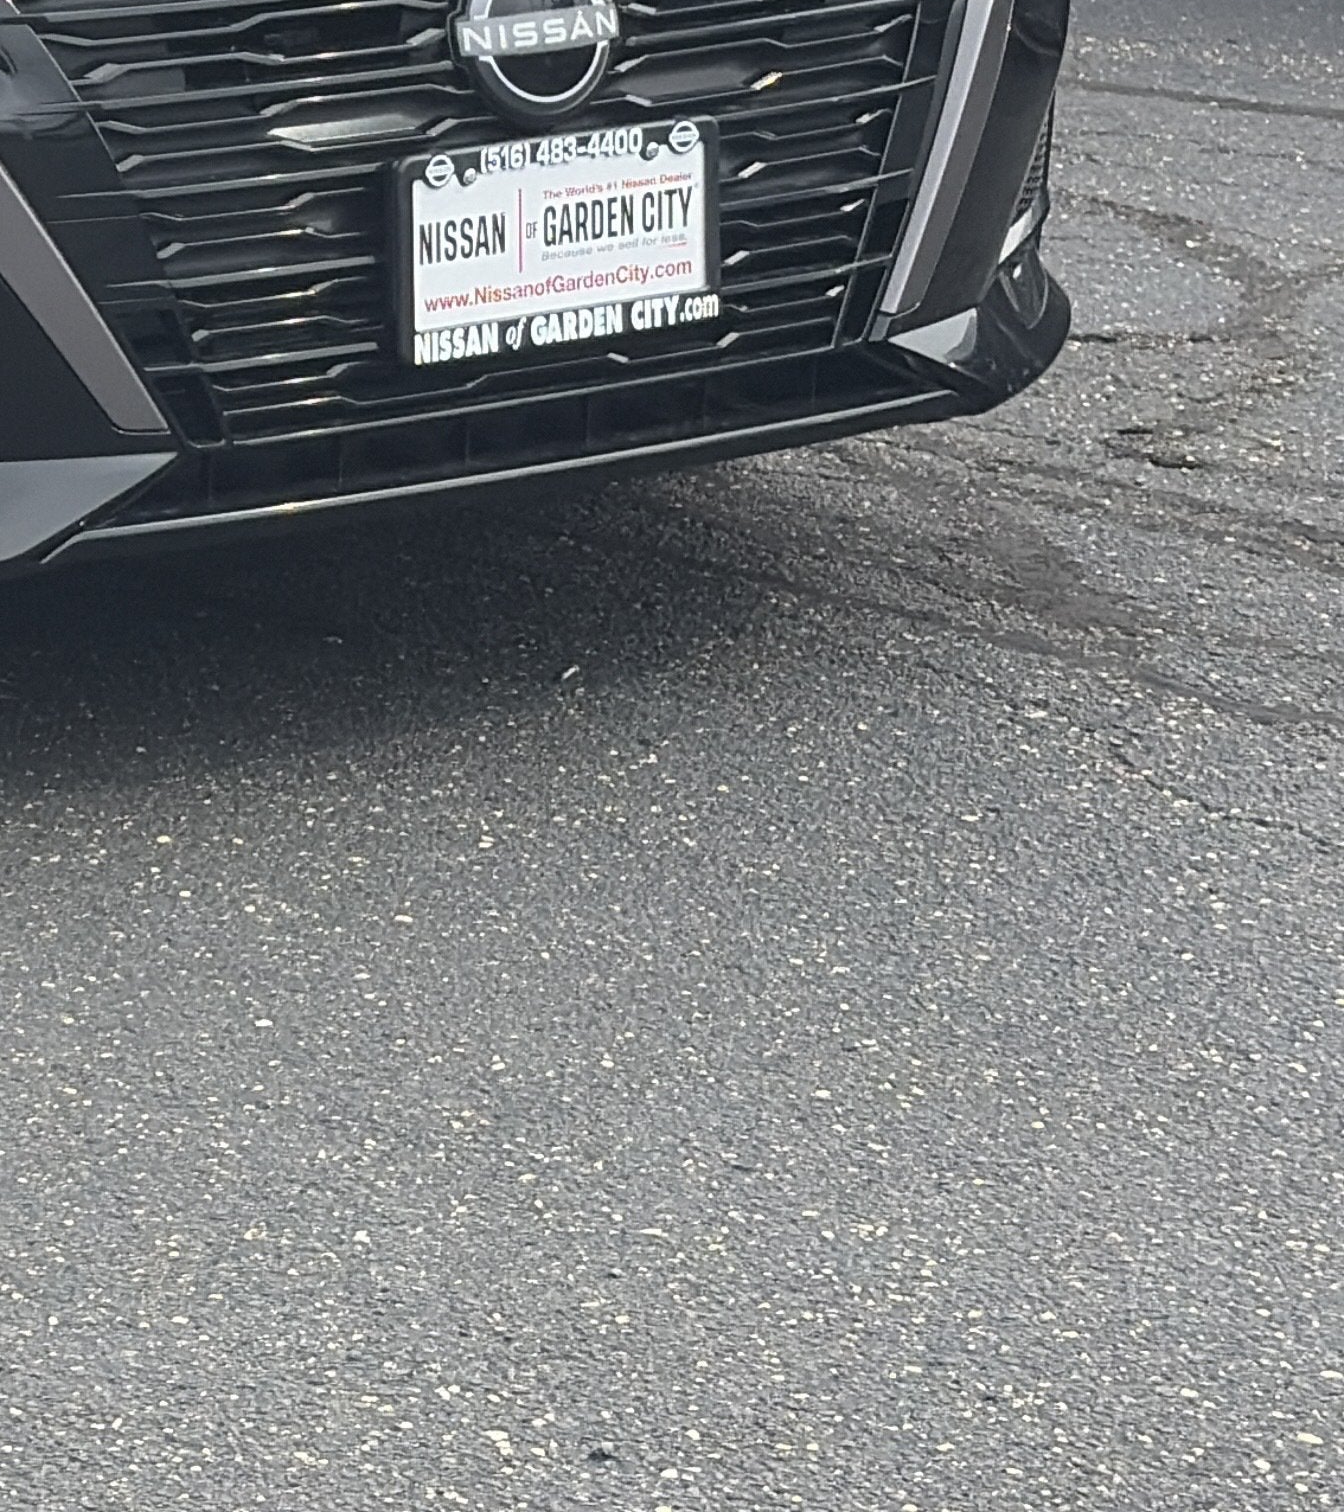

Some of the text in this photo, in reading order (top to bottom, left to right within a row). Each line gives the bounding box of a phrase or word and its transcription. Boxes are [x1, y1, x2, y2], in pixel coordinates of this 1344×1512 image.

[462, 8, 617, 52] NISSAN
[480, 127, 643, 174] (516) 483-4400
[543, 189, 562, 199] The
[621, 178, 657, 190] Nissan
[659, 172, 693, 185] Dealer
[419, 186, 693, 266] NISSAN OF GARDEN CITY
[424, 260, 692, 312] www.NissanofGardenCity.com
[414, 293, 719, 365] NISSAN of GARDEN CITY.com
